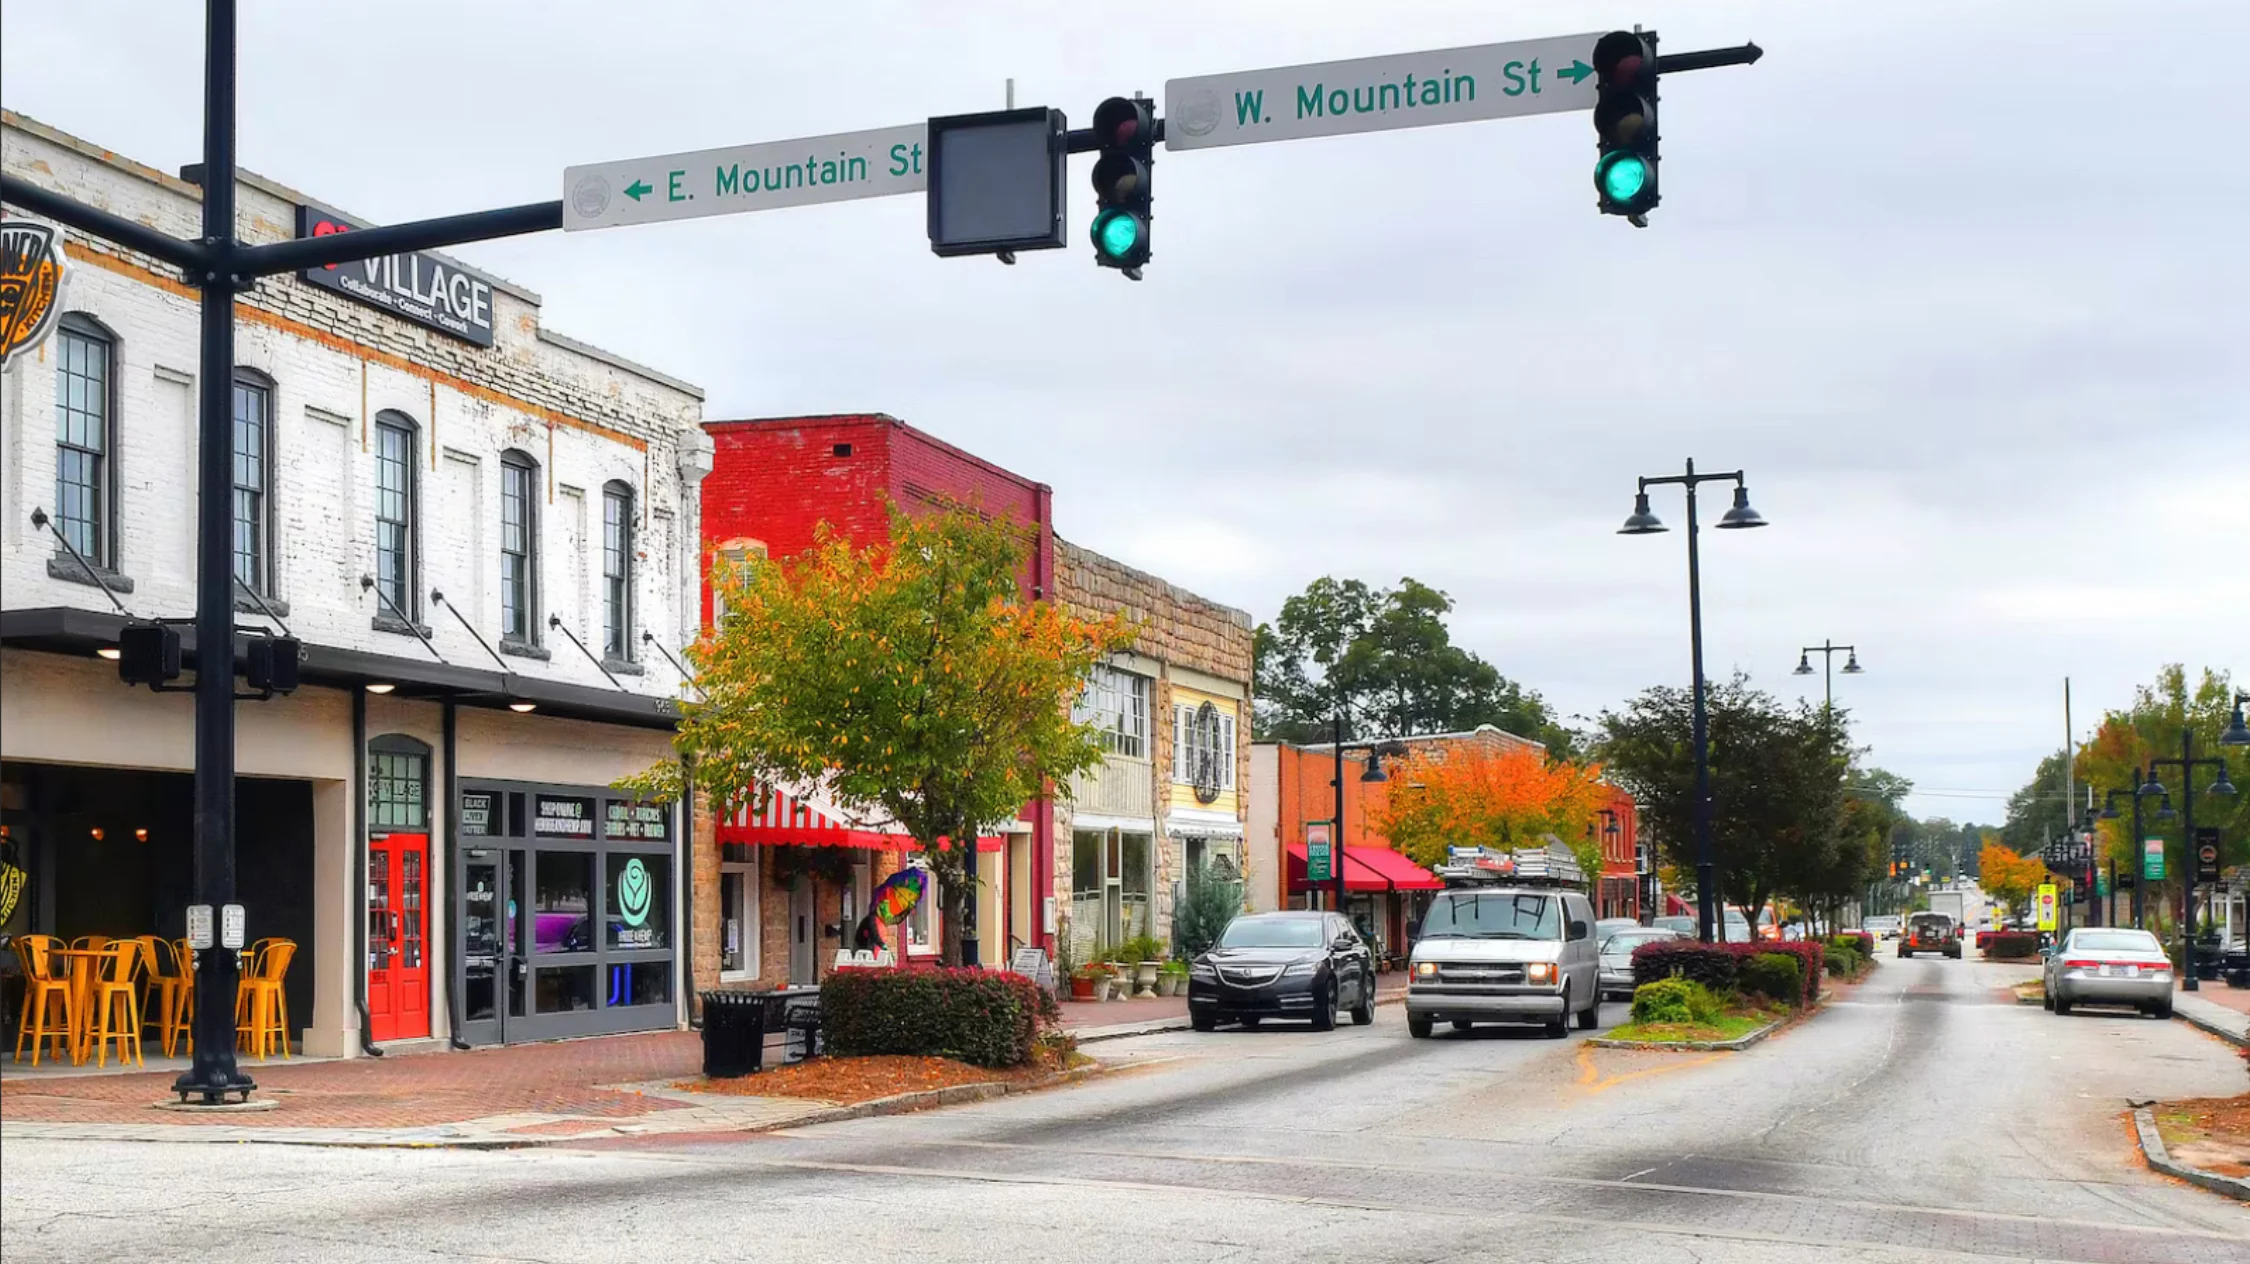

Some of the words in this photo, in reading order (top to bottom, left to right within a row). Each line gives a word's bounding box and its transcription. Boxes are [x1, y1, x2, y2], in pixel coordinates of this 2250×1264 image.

[1235, 88, 1271, 126] W.
[1297, 70, 1476, 119] Mountain
[1502, 58, 1542, 97] St
[667, 169, 695, 202] E.
[716, 149, 867, 196] Mountain
[888, 142, 922, 178] St
[1, 230, 43, 277] NED
[23, 271, 53, 332] KITCHEN
[340, 275, 393, 305] Collaborate
[399, 298, 433, 321] Connect
[438, 312, 469, 335] Cowork
[363, 253, 491, 329] VILLAGE
[384, 781, 420, 797] VLLAGE
[465, 798, 487, 809] BLACK
